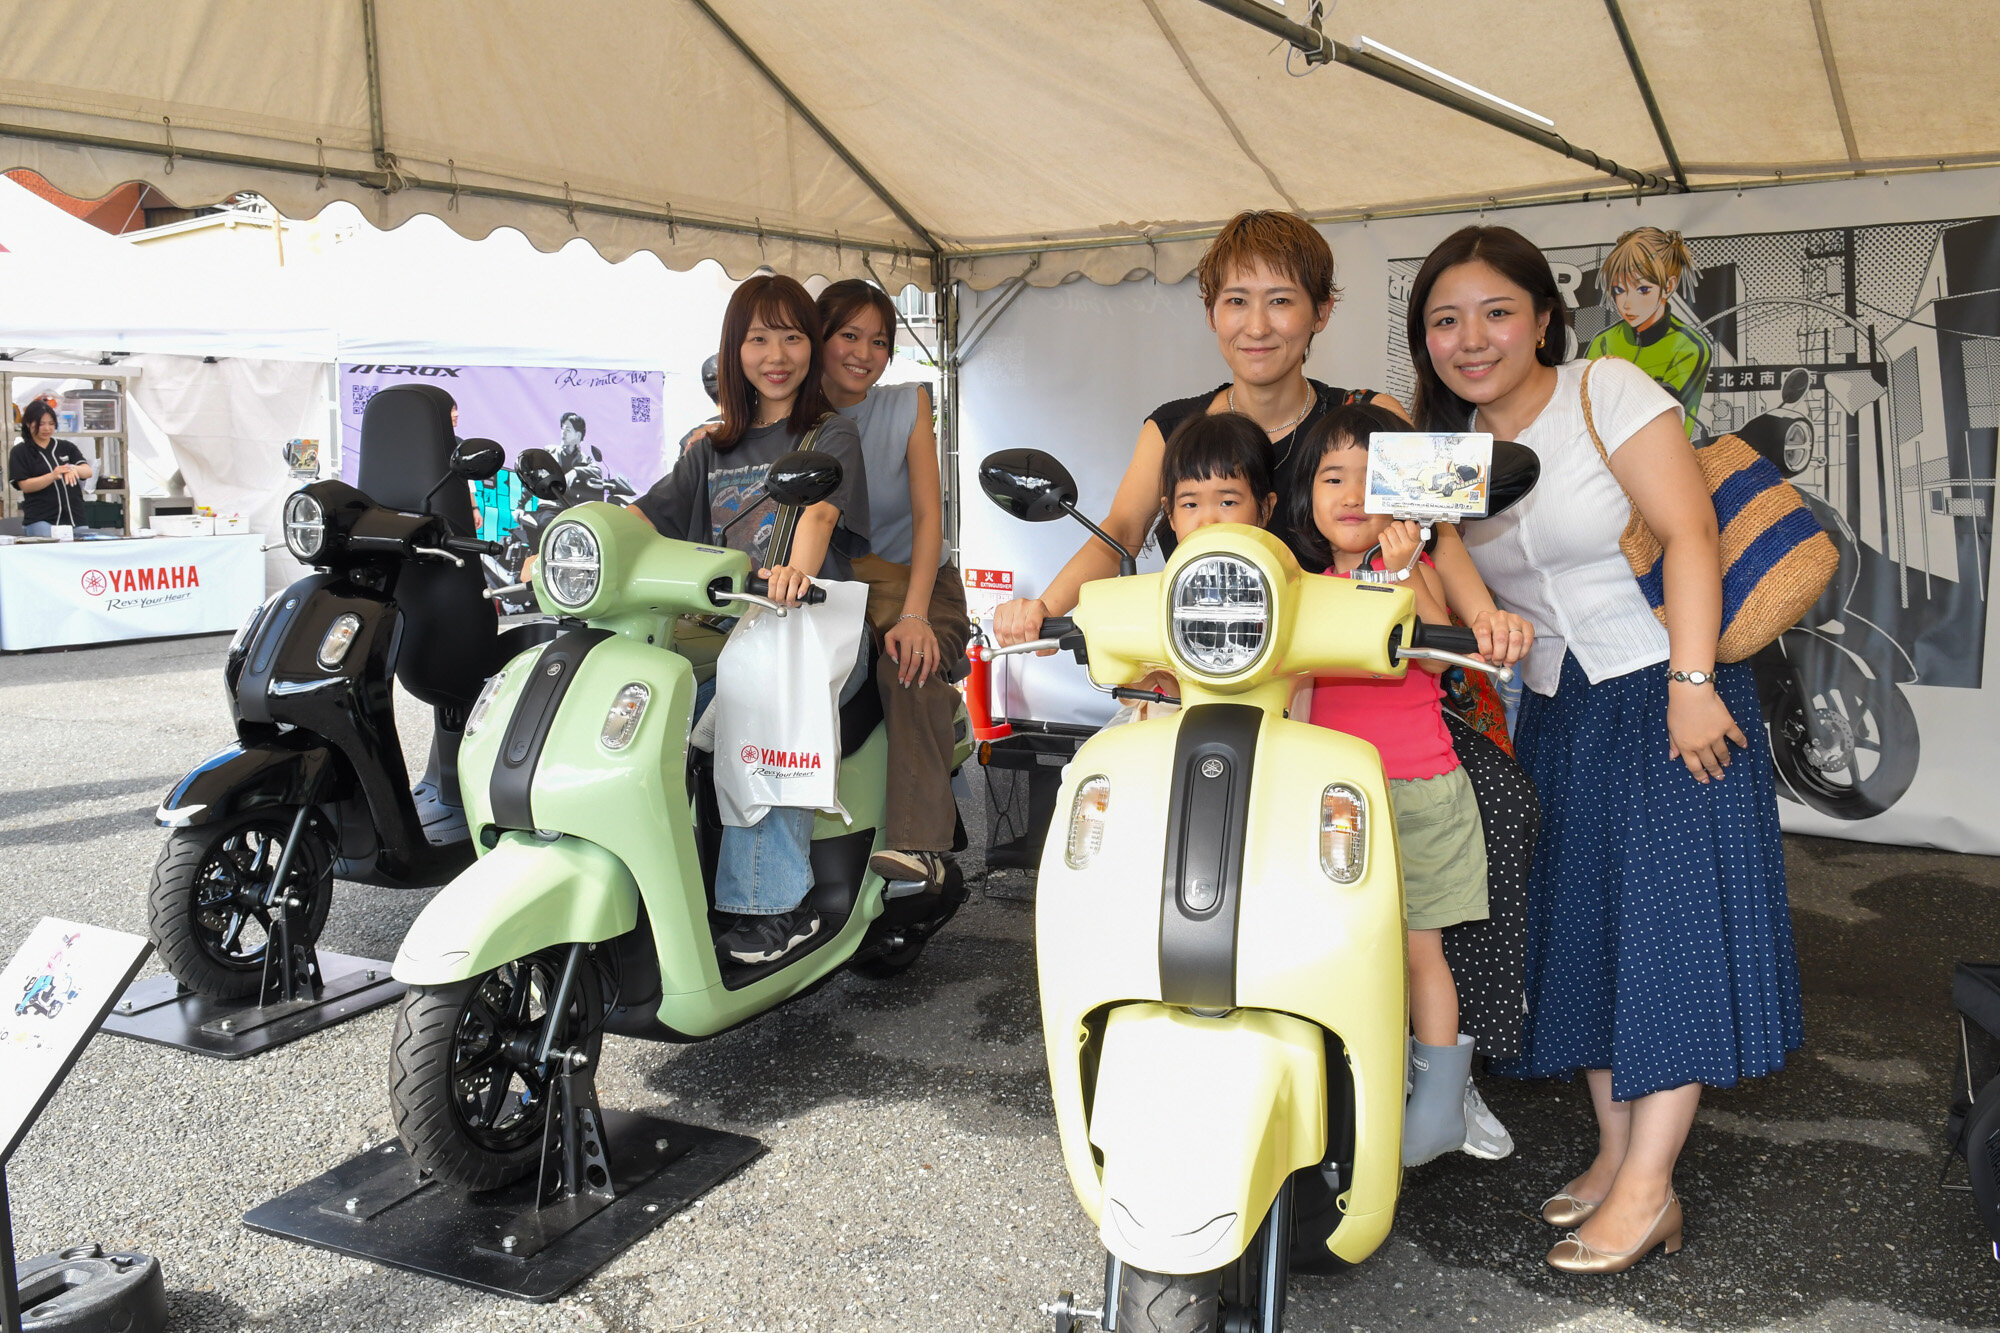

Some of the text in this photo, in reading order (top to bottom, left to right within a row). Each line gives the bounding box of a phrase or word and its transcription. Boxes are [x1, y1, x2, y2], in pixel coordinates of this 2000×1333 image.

[109, 565, 199, 593] YAMAHA
[105, 592, 191, 611] Revs Your Heart
[761, 748, 821, 769] YAMAHA
[752, 768, 776, 776] Revs
